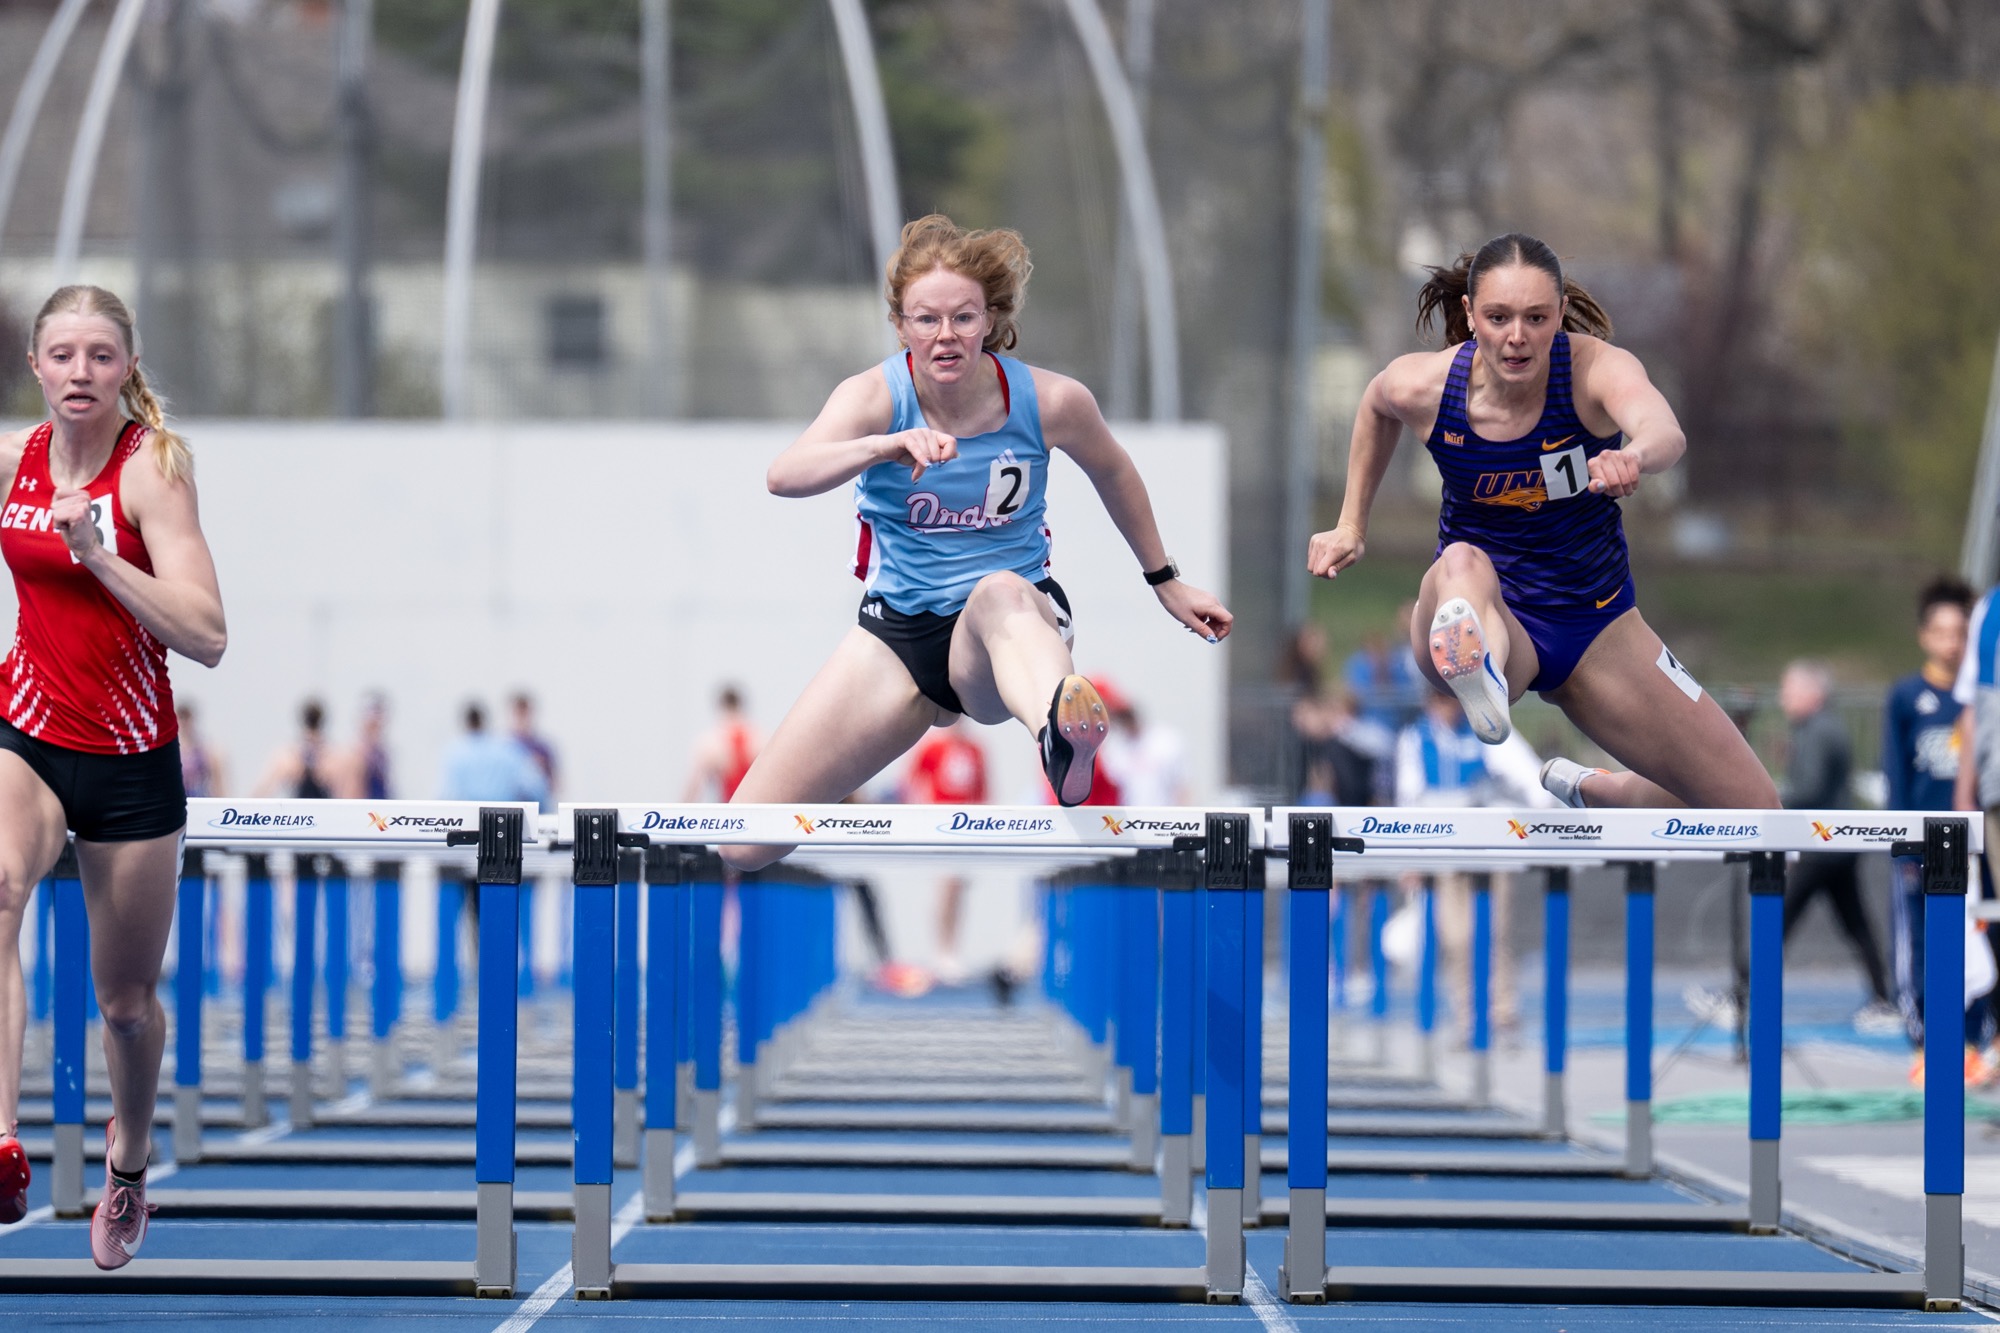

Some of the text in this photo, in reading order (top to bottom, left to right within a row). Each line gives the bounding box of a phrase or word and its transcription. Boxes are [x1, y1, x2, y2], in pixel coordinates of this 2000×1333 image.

[1554, 453, 1578, 495] 1
[996, 466, 1022, 515] 2
[1473, 469, 1547, 499] UN
[905, 484, 1013, 530] Dra
[0, 502, 60, 533] CEN
[220, 808, 315, 826] Drake RELAYS
[388, 815, 464, 827] XTREAM
[642, 811, 745, 830] Drake RELAYS
[816, 818, 892, 828] XTREAM
[950, 812, 1053, 831] Drake RELAYS
[1123, 819, 1200, 831] XTREAM
[1360, 816, 1454, 834] Drake RELAYS
[1528, 823, 1603, 834] XTREAM
[1664, 818, 1759, 836] Drake RELAYS
[1833, 825, 1908, 836] XTREAM
[582, 871, 610, 881] GILL
[1213, 876, 1241, 885] GILL
[1931, 880, 1961, 890] GILL
